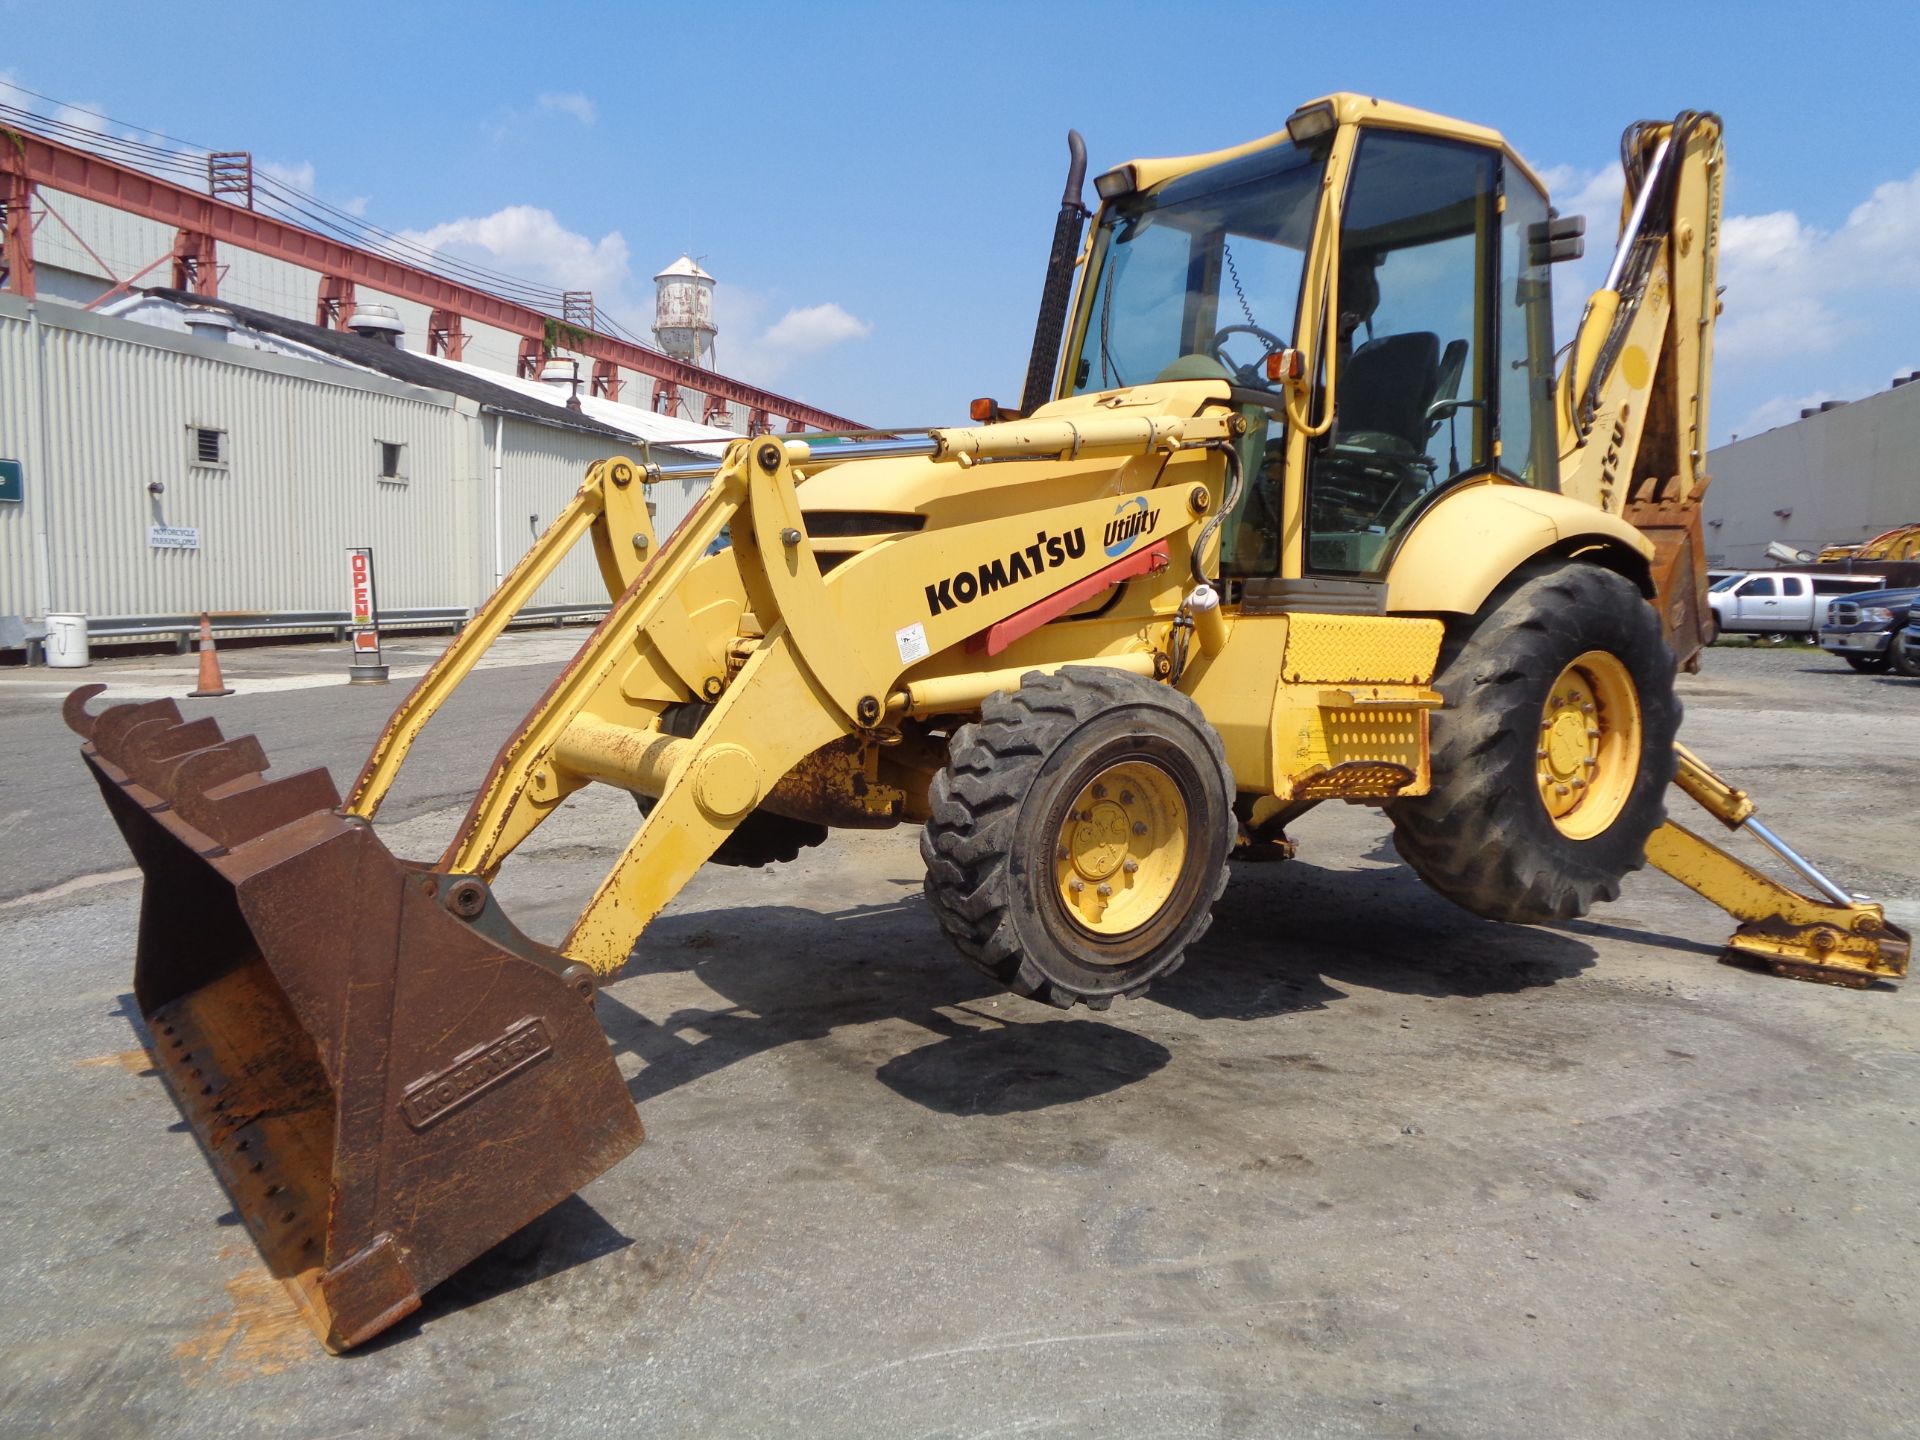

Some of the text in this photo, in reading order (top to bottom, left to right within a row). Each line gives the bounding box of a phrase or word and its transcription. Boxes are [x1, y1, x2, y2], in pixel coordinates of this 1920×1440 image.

[153, 528, 196, 537] MOTORCYCLE
[1103, 508, 1160, 548] Utility
[352, 555, 369, 617] OPEN
[924, 526, 1086, 617] KOMATSU
[411, 1027, 541, 1120] KOMATSU
